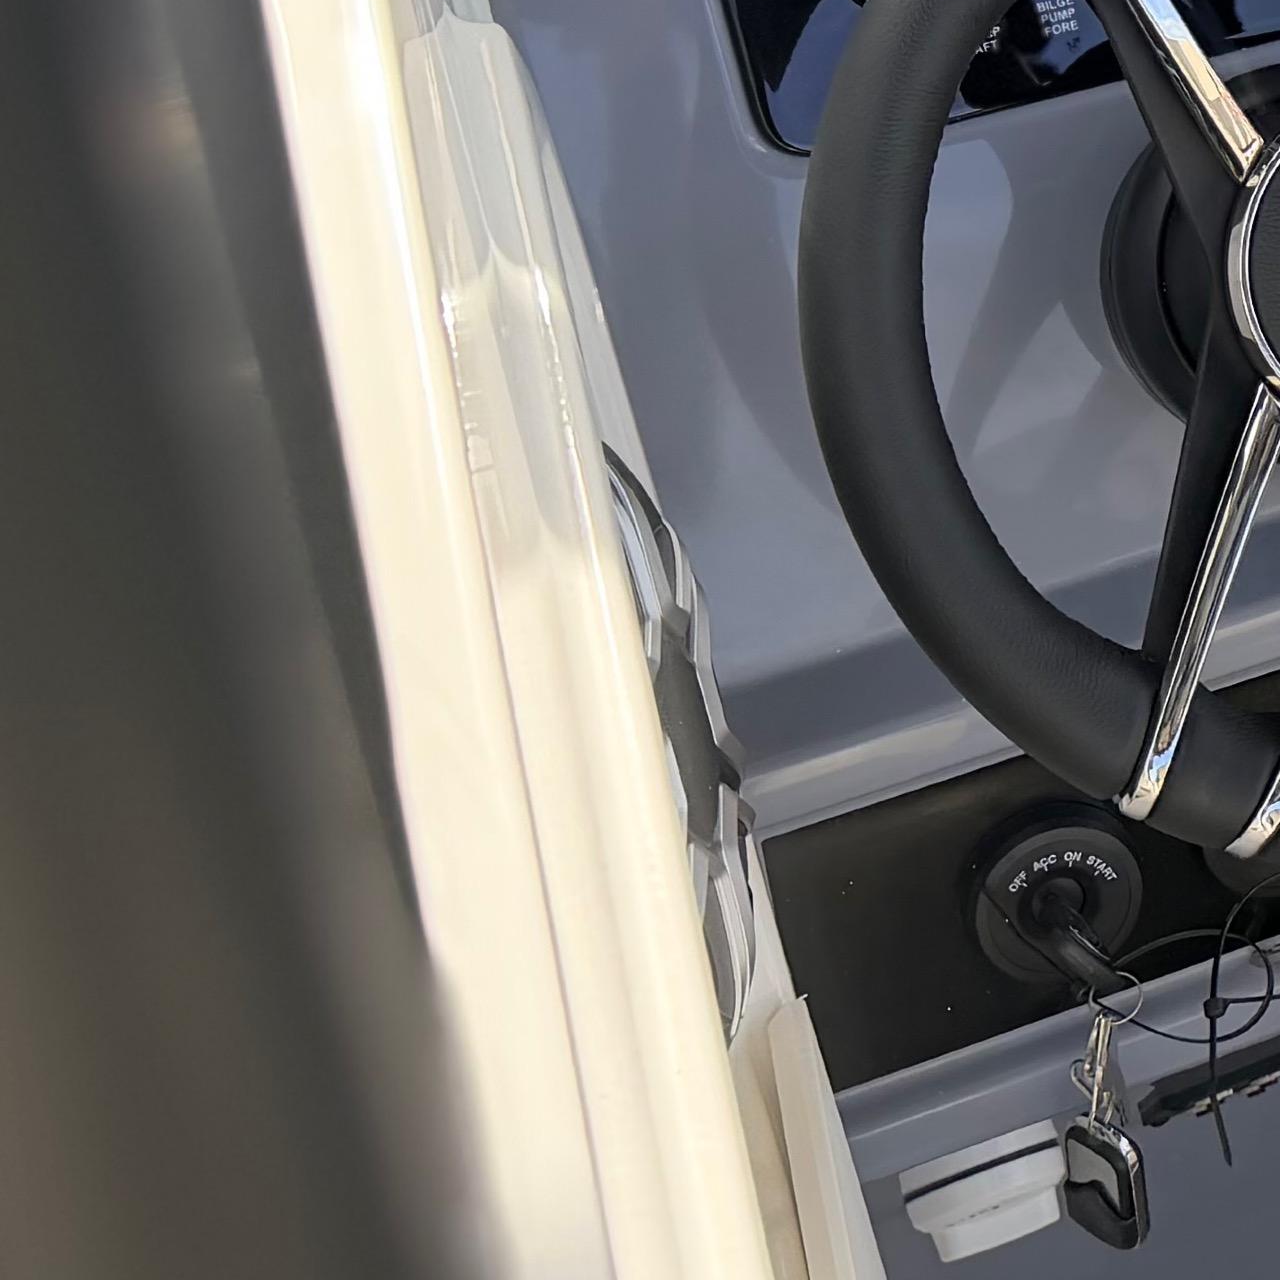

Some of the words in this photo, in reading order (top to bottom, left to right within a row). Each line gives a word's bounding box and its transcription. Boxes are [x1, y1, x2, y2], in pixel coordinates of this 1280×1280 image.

[1040, 7, 1076, 25] PUMP
[1043, 19, 1080, 38] FORE
[1008, 870, 1028, 892] OFF
[1033, 854, 1058, 872] ACC
[1063, 851, 1082, 863] ON
[1086, 855, 1118, 880] START
